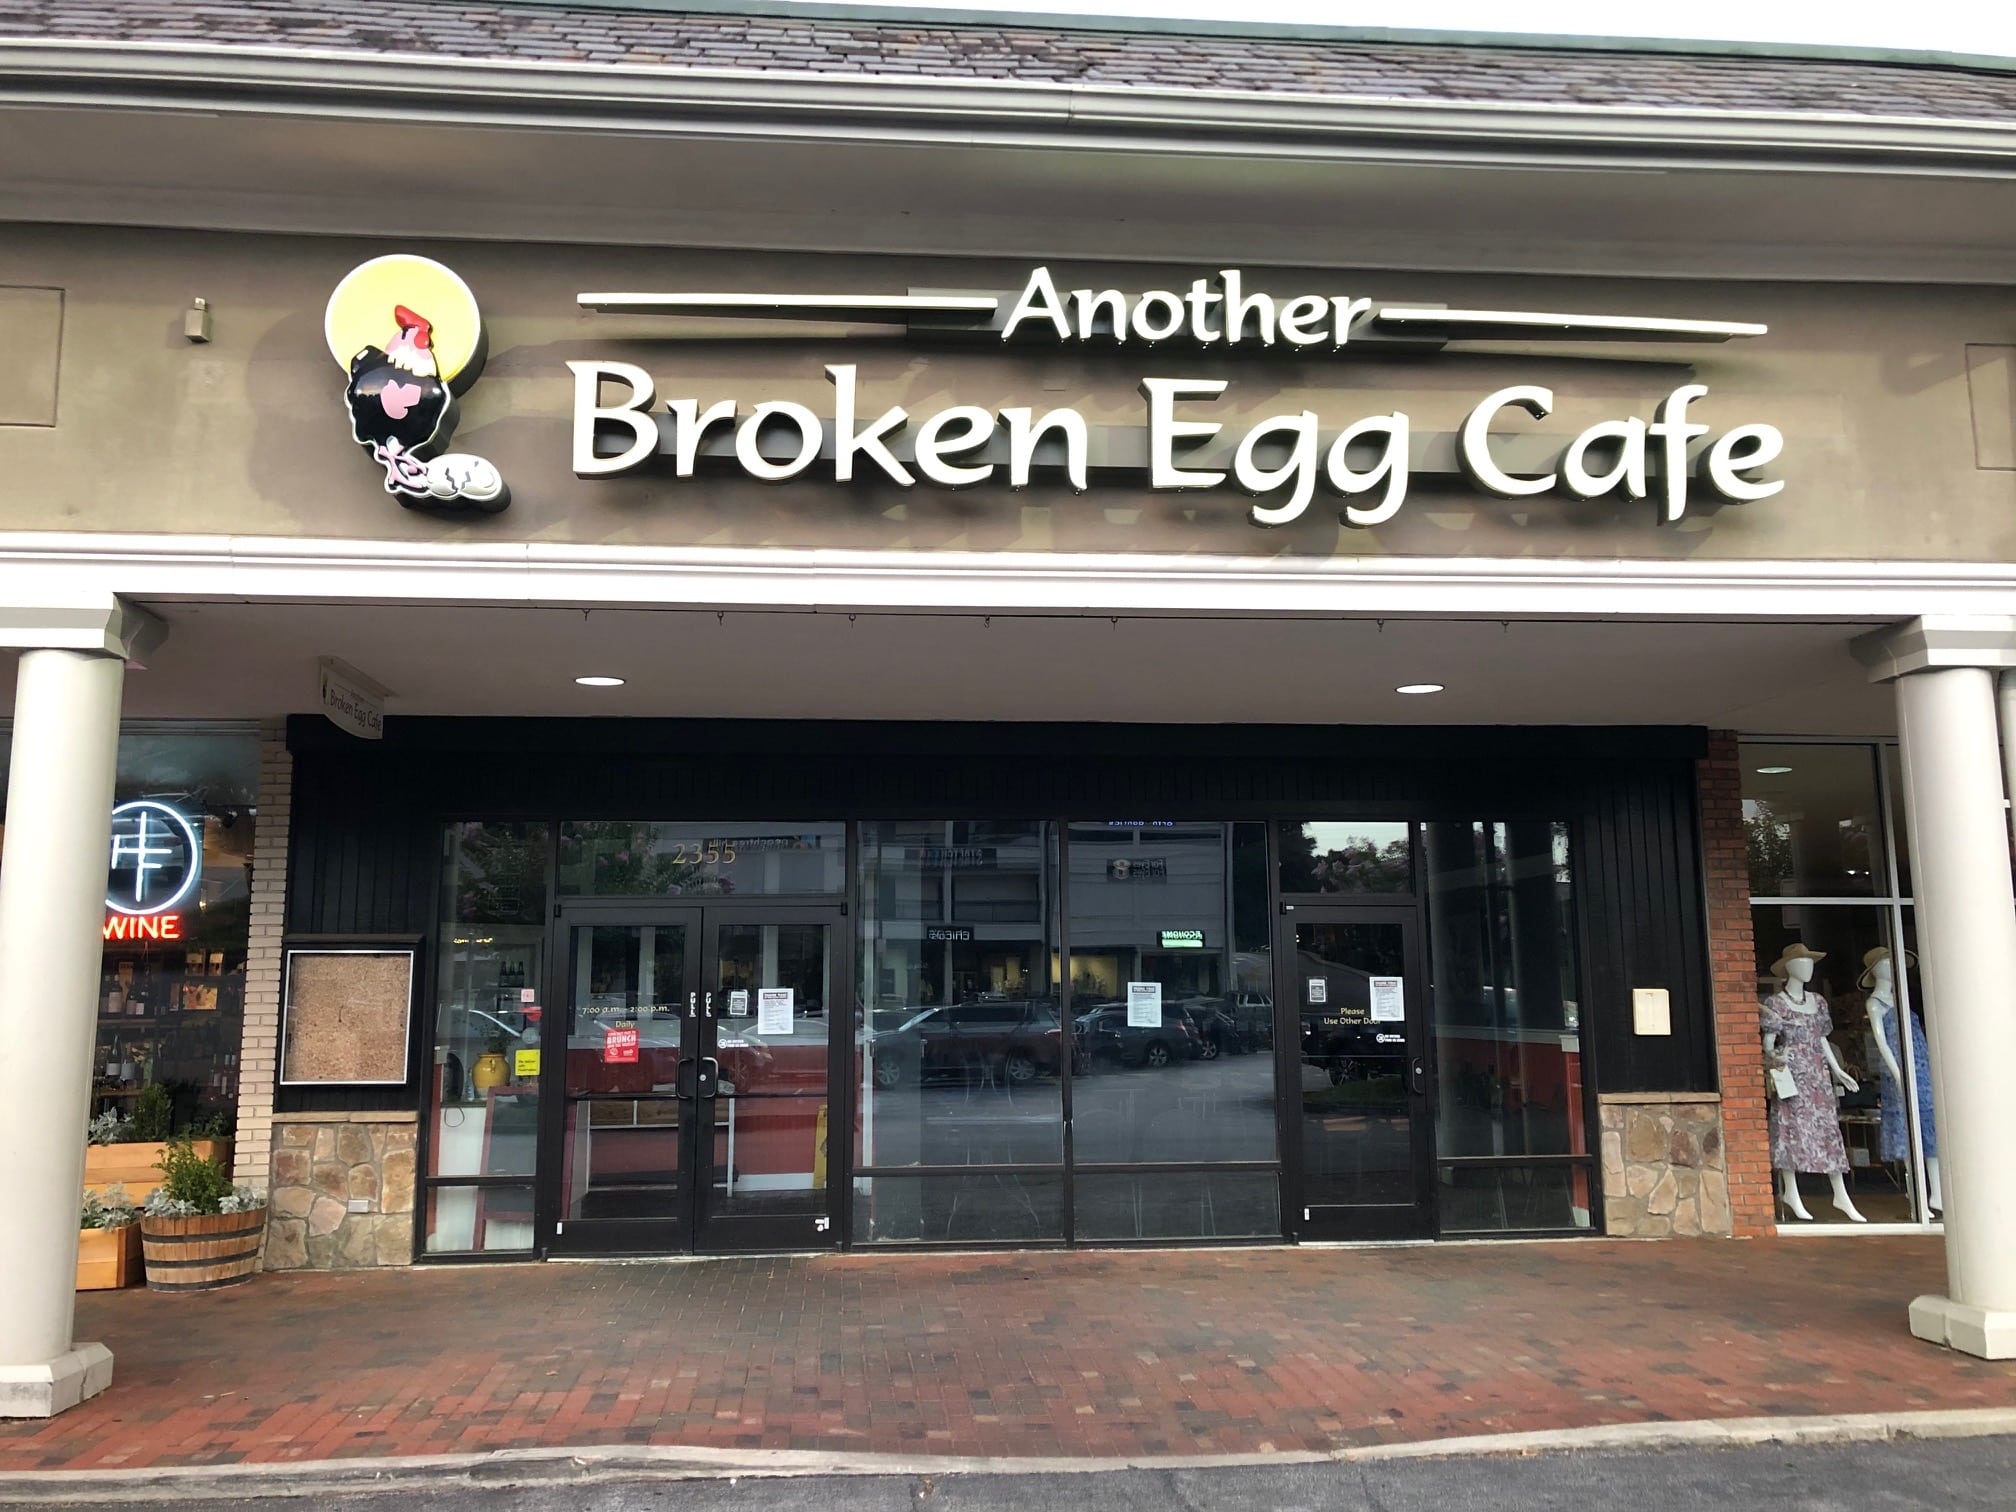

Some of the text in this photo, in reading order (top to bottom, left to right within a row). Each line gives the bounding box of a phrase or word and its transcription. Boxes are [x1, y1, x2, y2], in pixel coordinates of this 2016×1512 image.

[1001, 266, 1374, 348] Another
[565, 359, 1786, 526] Broken Egg Cafe
[330, 688, 353, 716] Broken
[354, 703, 366, 727] Egg
[671, 842, 737, 865] 2355
[103, 915, 180, 940] WINE
[582, 1007, 600, 1015] 7:00
[629, 1005, 648, 1013] 2:00
[650, 1005, 670, 1014] p.m.
[689, 991, 697, 1015] PULL
[1340, 1007, 1365, 1015] Please
[615, 1020, 635, 1029] Daily
[1323, 1017, 1338, 1025] Use
[1339, 1017, 1362, 1025] Other
[606, 1034, 636, 1045] BRUNCH
